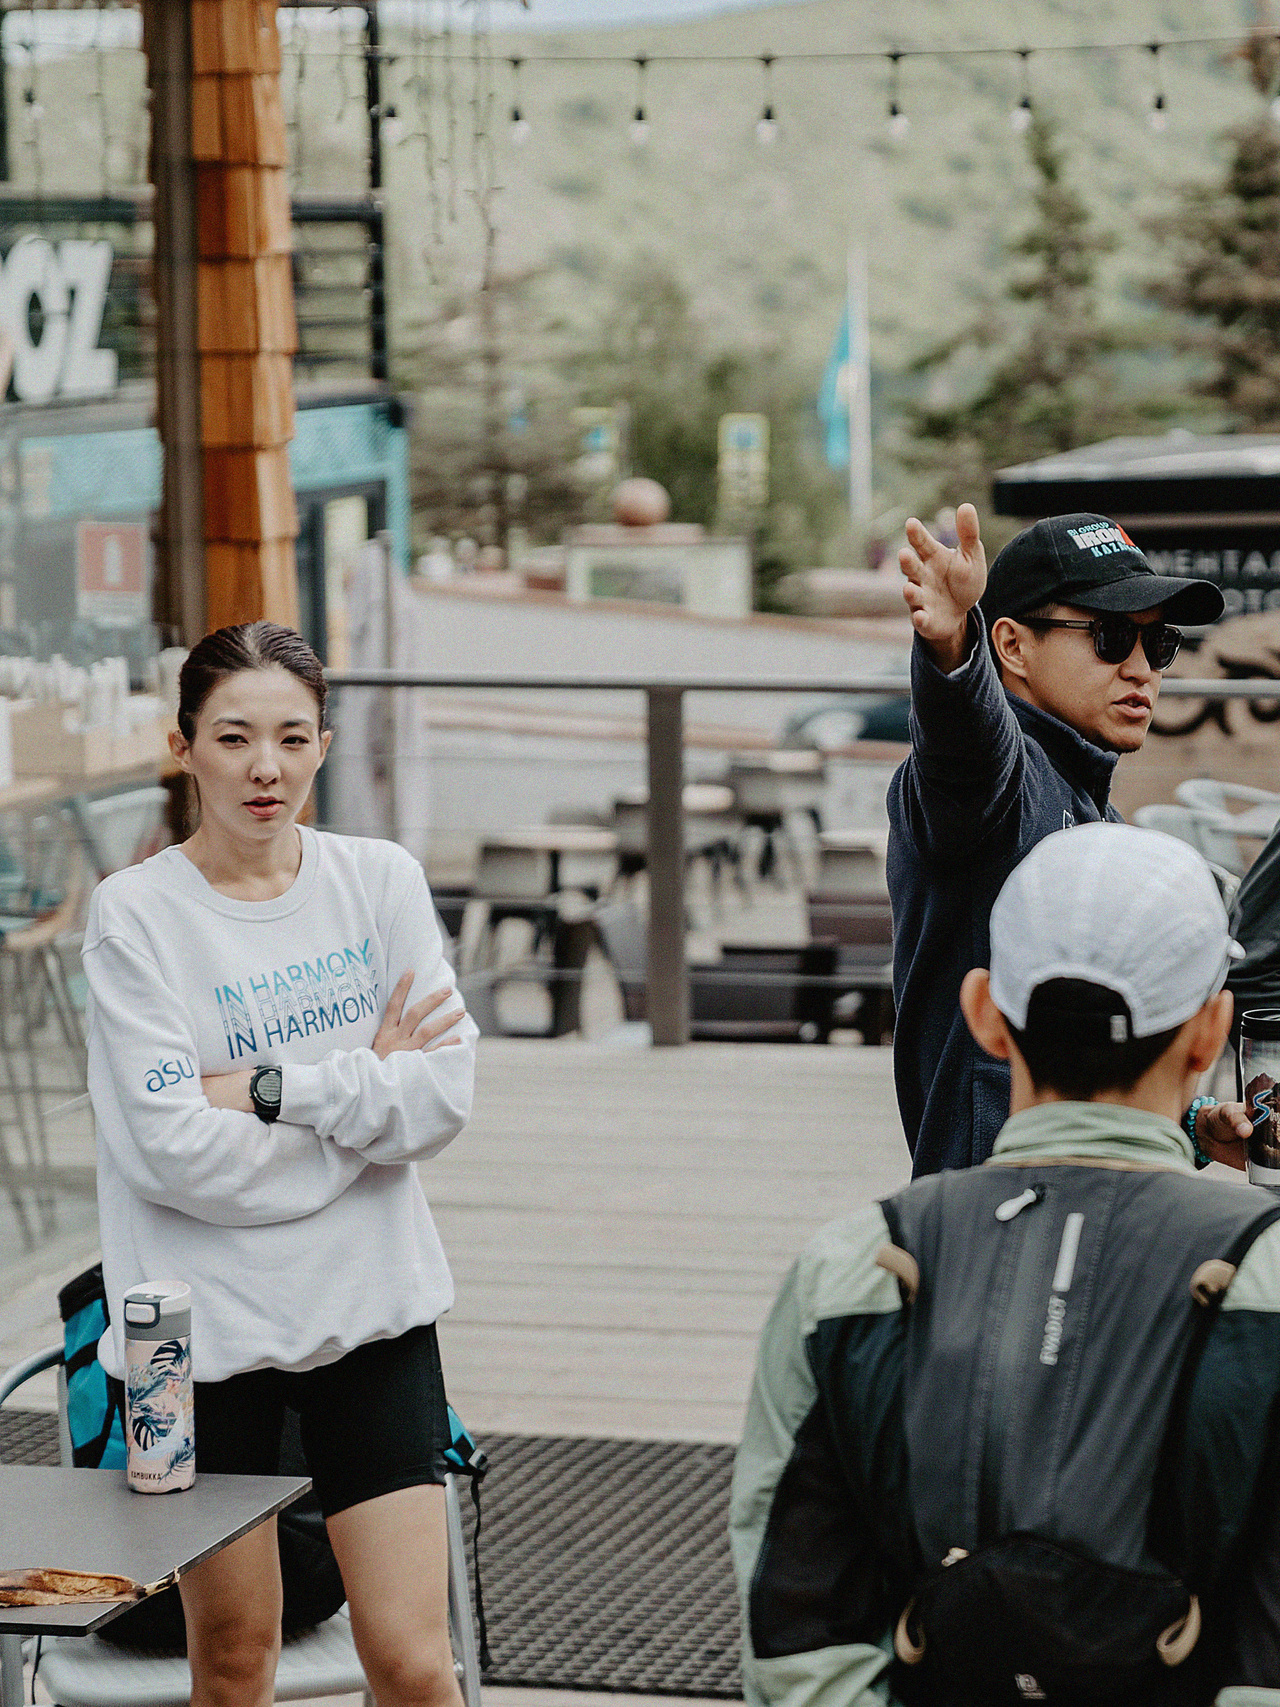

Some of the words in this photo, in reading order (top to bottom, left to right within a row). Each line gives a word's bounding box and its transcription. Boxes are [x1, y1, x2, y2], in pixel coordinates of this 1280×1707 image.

[1067, 529, 1079, 537] BI
[1078, 522, 1110, 534] GROUP
[214, 981, 244, 1005] IN
[249, 938, 370, 996] HARMONY
[227, 1026, 258, 1060] IN
[264, 983, 380, 1048] HARMONY
[1039, 1294, 1067, 1366] EVADICT
